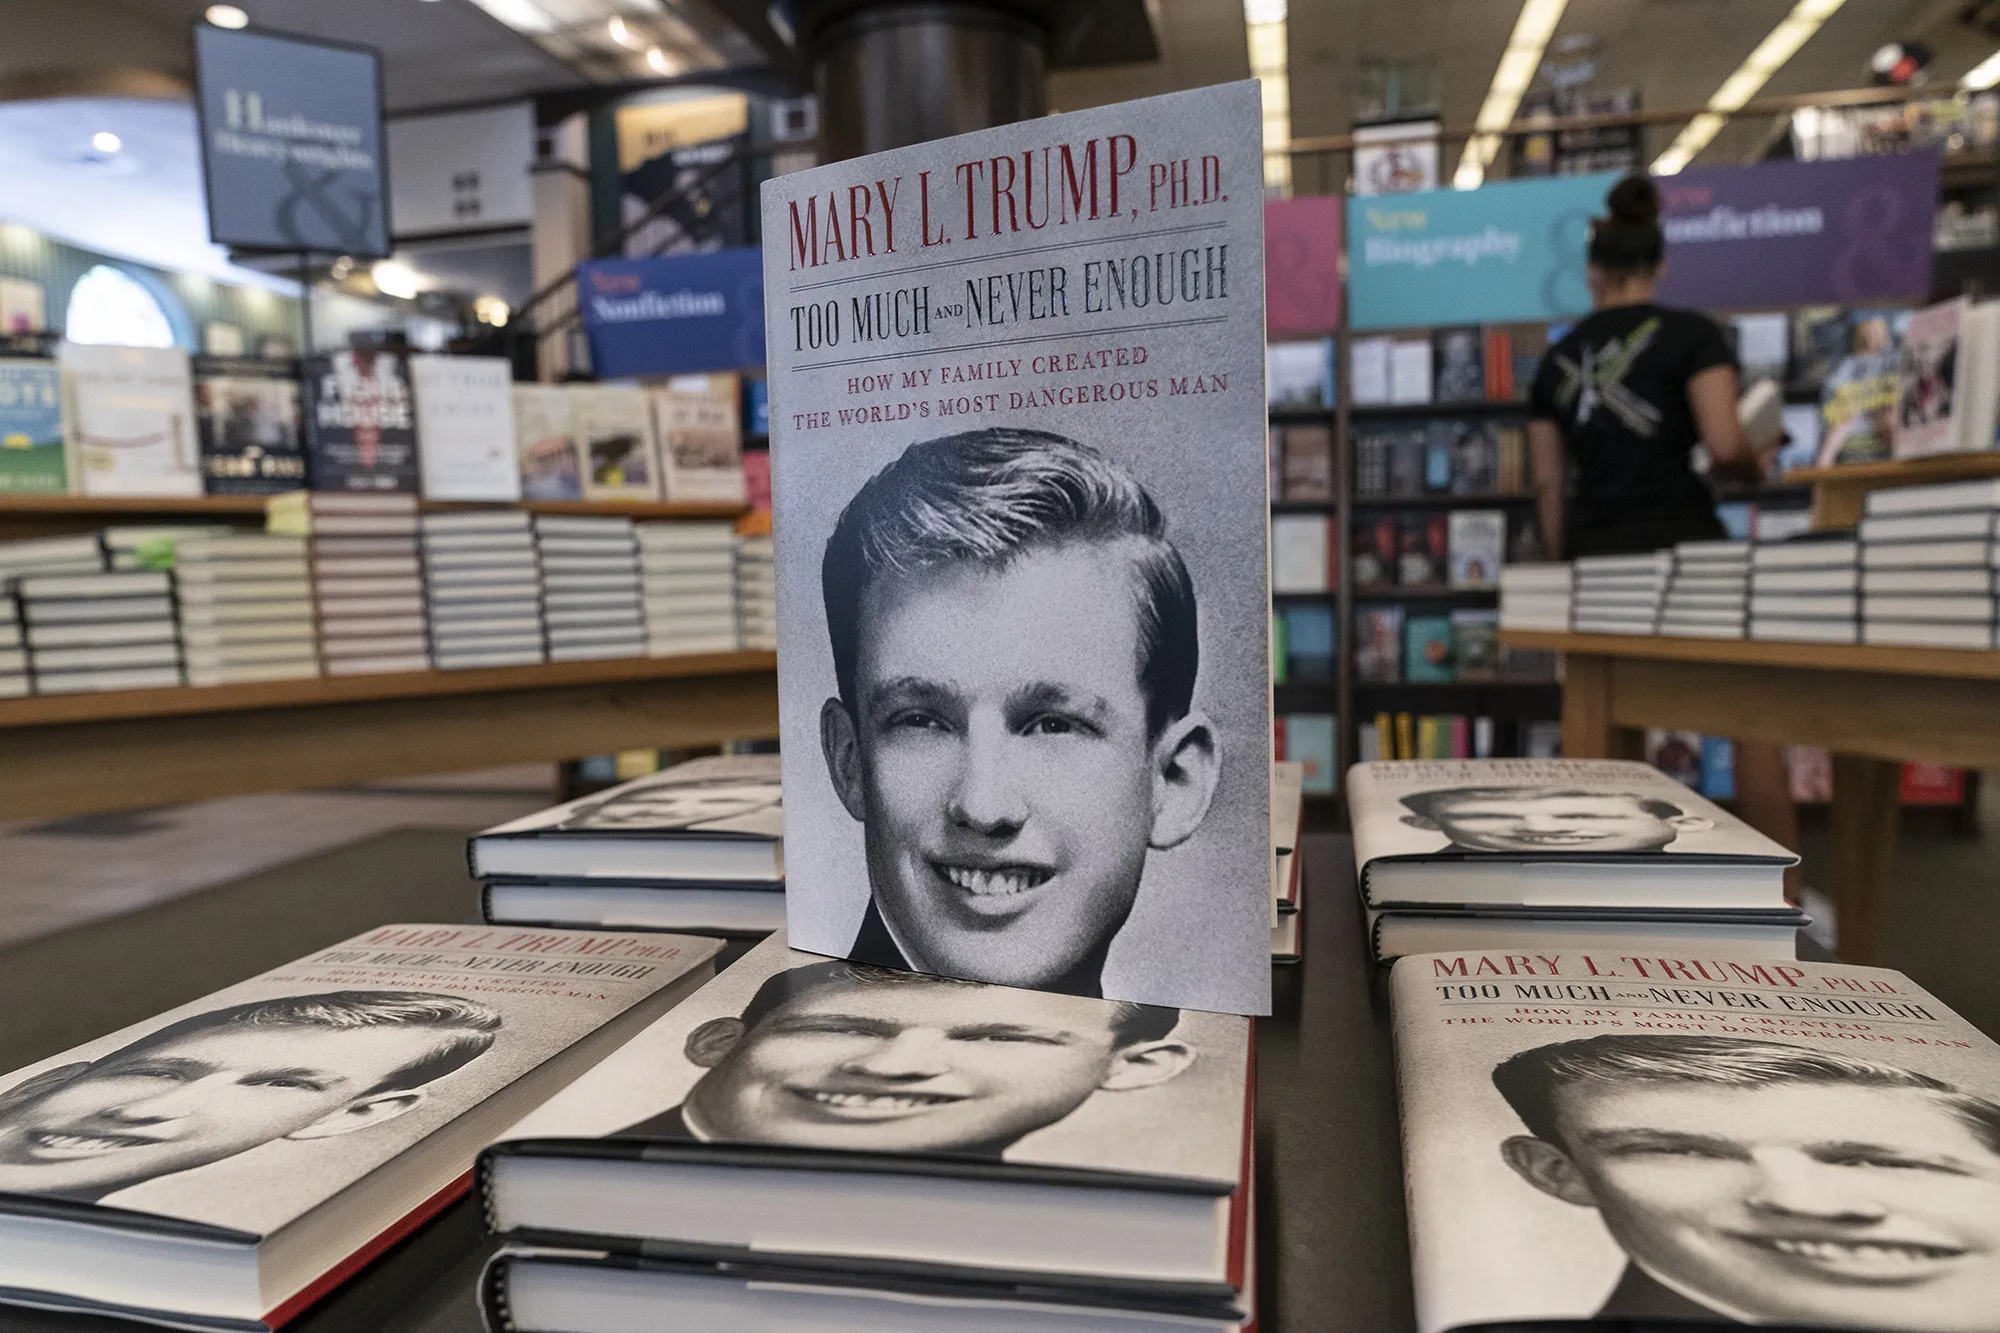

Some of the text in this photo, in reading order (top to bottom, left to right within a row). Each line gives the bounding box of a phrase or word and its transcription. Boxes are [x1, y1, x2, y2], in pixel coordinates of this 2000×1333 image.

[788, 134, 1228, 271] MARY L. TRUMP, PH.D.
[1366, 224, 1522, 268] Biography
[593, 289, 726, 323] Nonfiction
[791, 244, 1229, 351] TOO MUCH AND NEVER ENOUGH
[847, 346, 1149, 394] HOW MY FAMILY CREATED
[793, 373, 1229, 430] THE WORLD'S MOST DANGEROUS MAN
[366, 928, 461, 948] MARY
[312, 952, 370, 964] TOO
[368, 953, 443, 966] MUCH
[464, 956, 546, 973] NEVER
[542, 960, 659, 981] ENOUGH
[478, 976, 567, 988] CREATED
[1433, 955, 1908, 996] MARY L. TRUMP, PH.D.
[564, 990, 612, 1001] MAN
[1436, 984, 1500, 1000] TOO
[1515, 984, 1611, 1001] MUCH
[1649, 987, 1772, 1010] NEVER
[1778, 995, 1938, 1021] ENOUGH
[1441, 1017, 1972, 1049] THE WORLD'S MOST DANGEROUS MAN
[1515, 1008, 1871, 1031] HOW MY FAMILY CREATED
